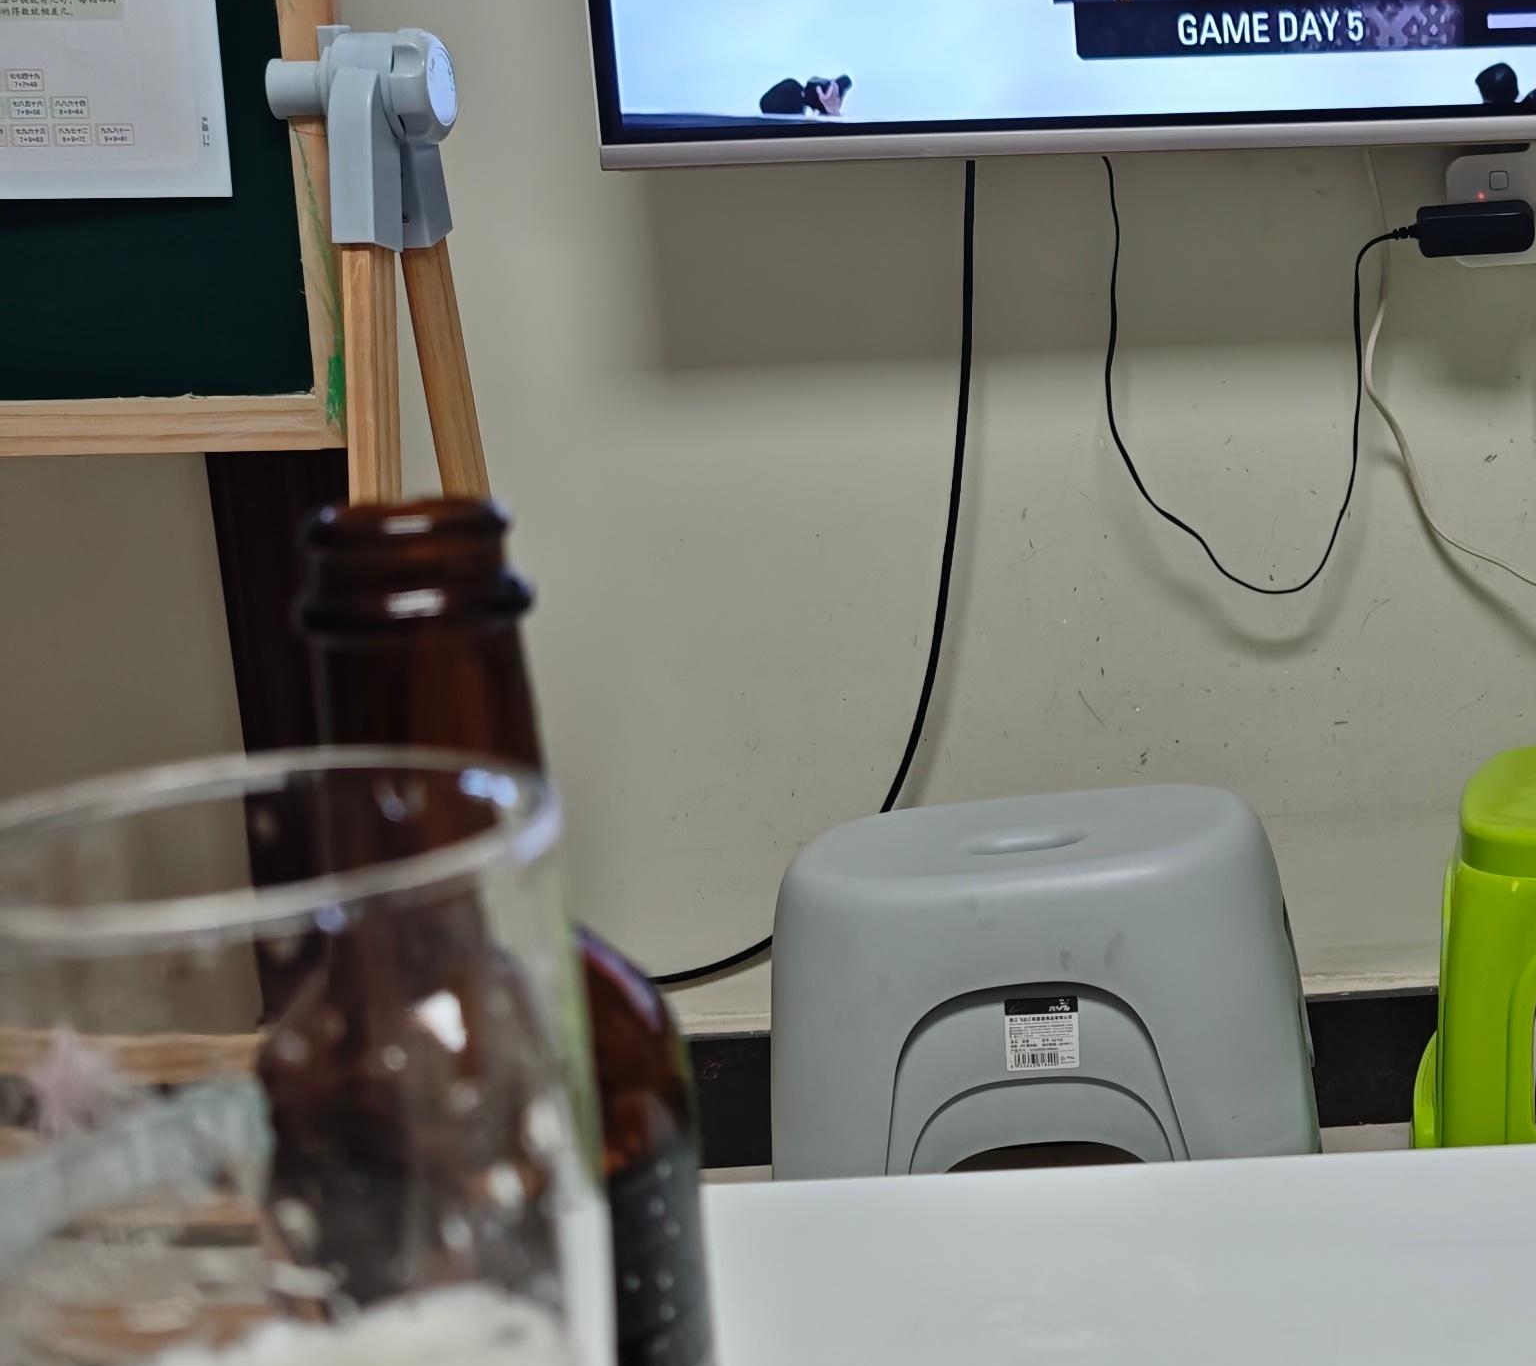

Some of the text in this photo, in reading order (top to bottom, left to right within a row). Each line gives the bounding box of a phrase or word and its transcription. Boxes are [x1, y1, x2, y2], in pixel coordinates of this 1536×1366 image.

[1178, 9, 1364, 46] GAME DAY 5
